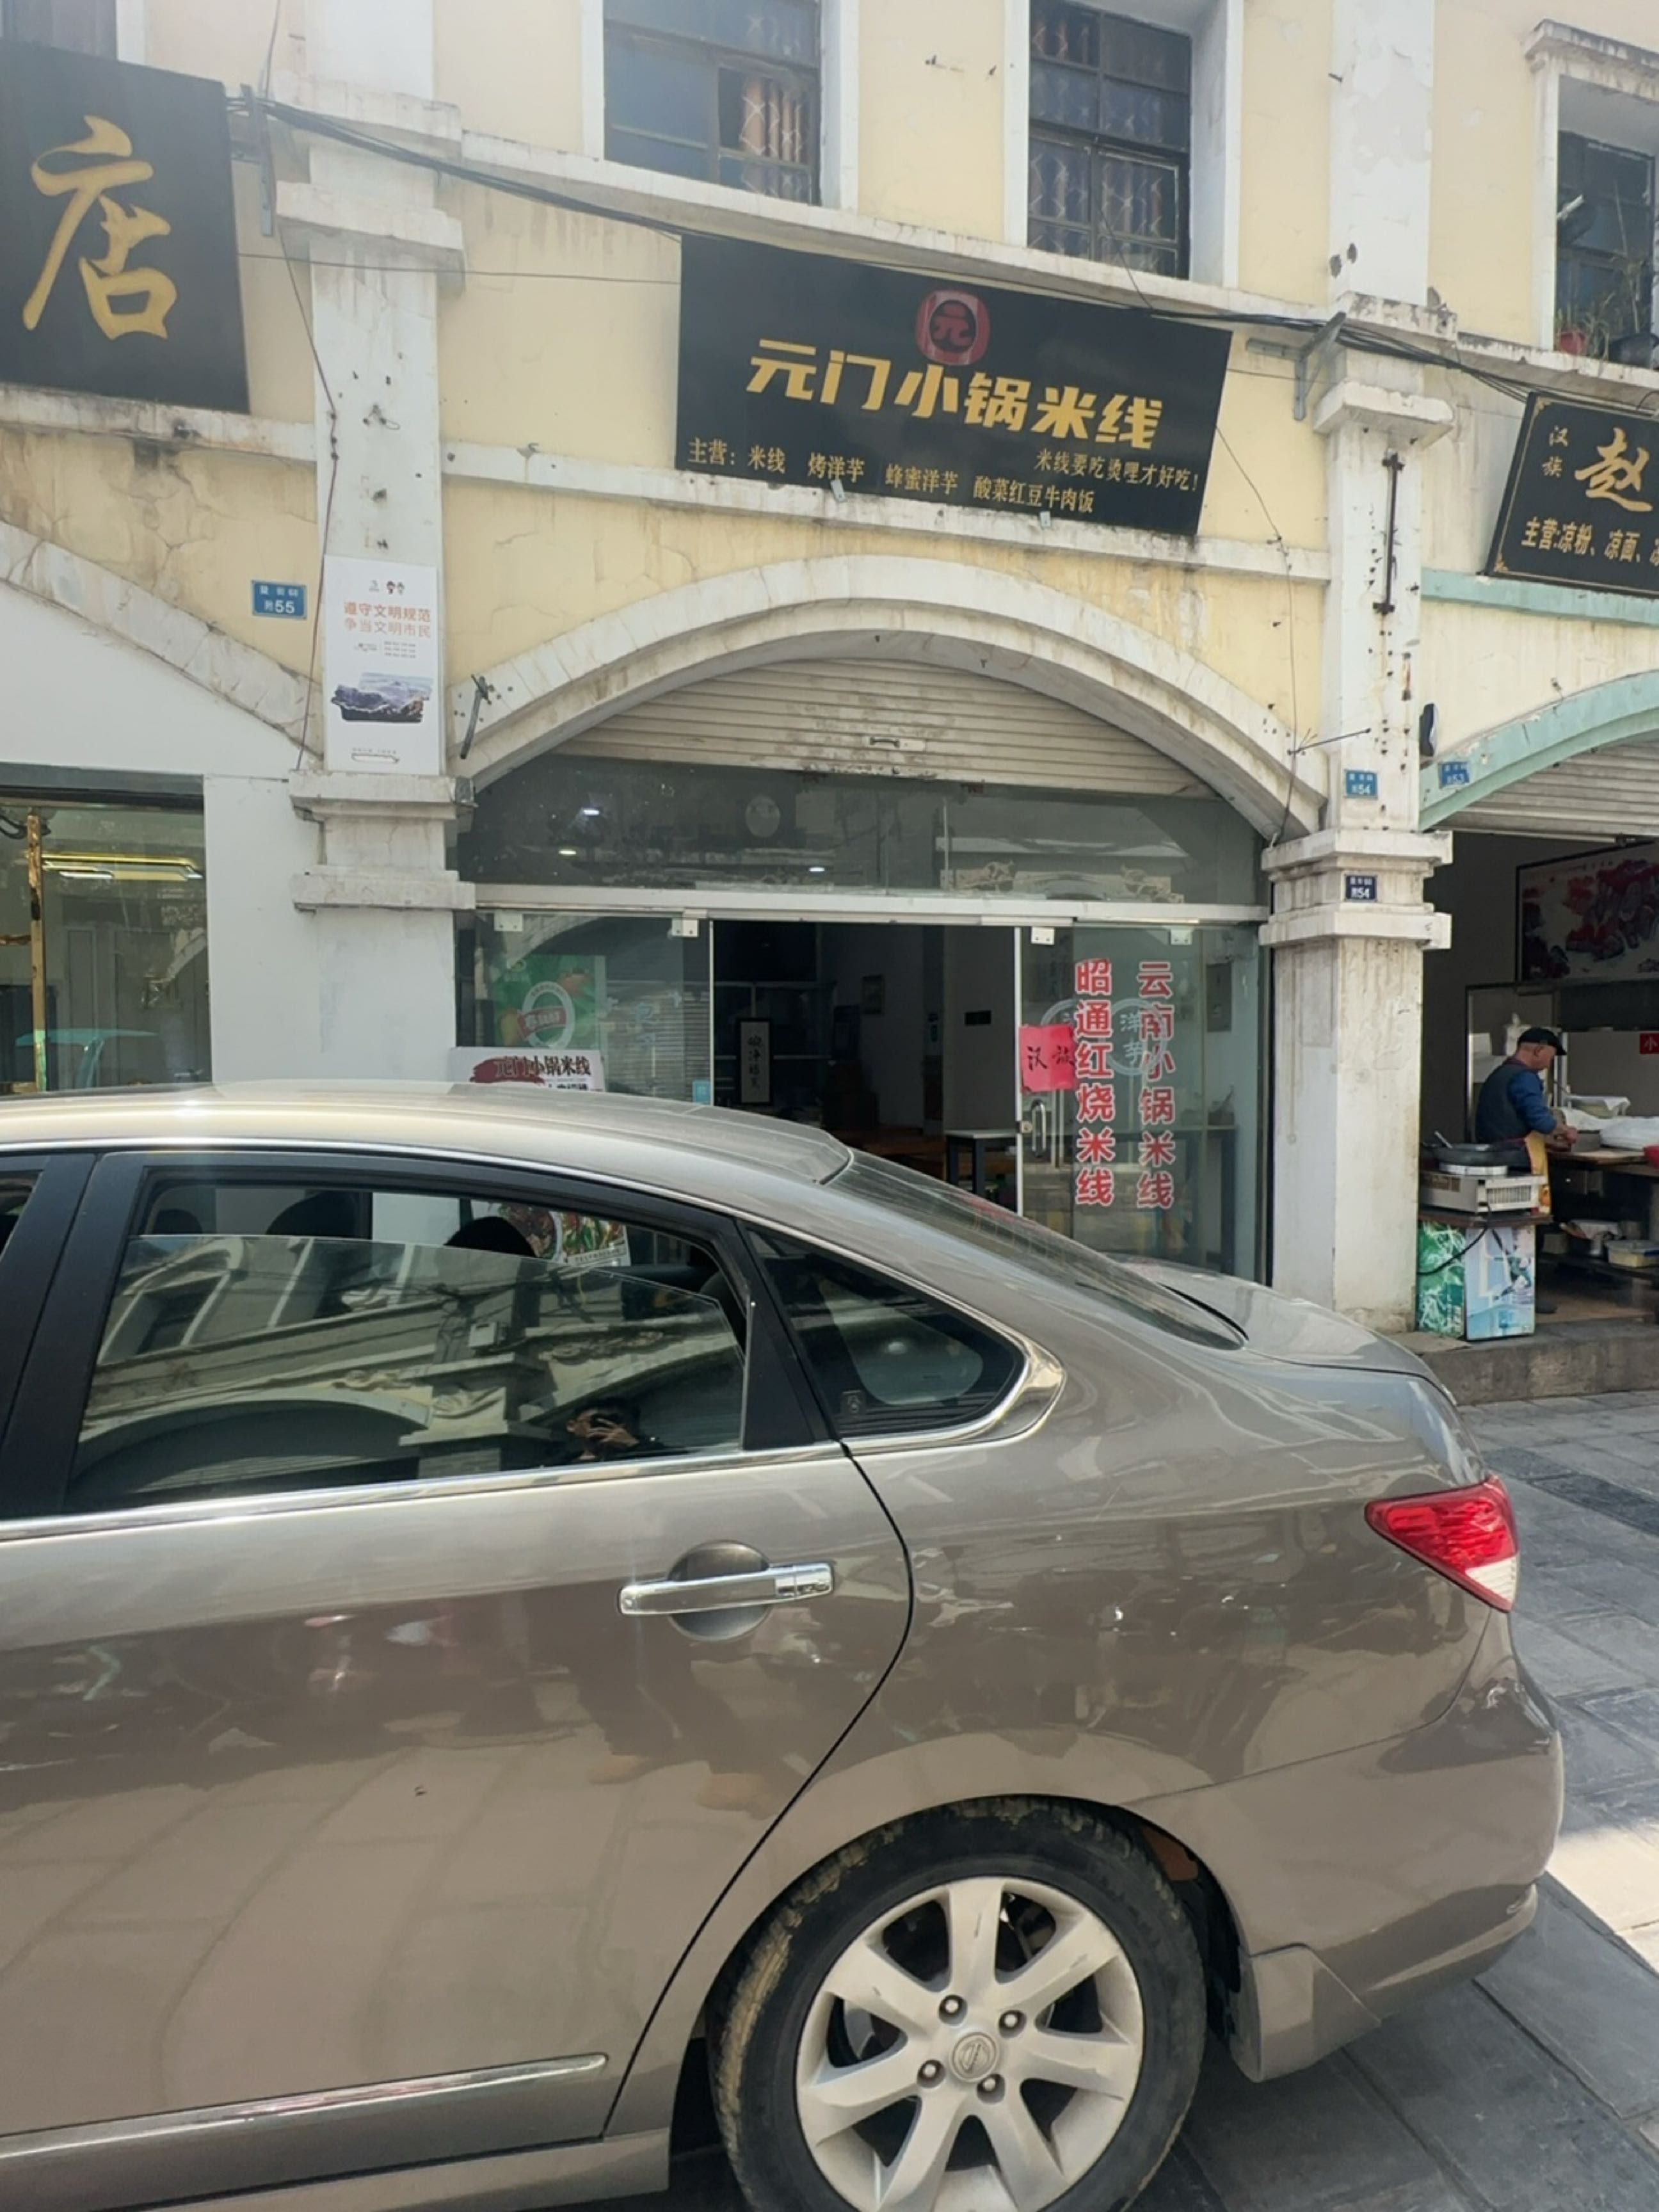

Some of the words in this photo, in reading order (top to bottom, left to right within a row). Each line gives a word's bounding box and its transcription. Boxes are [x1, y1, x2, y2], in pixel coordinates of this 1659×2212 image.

[22, 115, 178, 341] 店
[933, 303, 974, 346] 元
[746, 339, 1163, 449] 元门小锅米线
[807, 452, 865, 483] 烤洋芋
[885, 463, 958, 495] 蜂蜜洋芋
[973, 476, 1094, 513] 酸菜红豆牛肉饭
[1542, 425, 1569, 478] 汉族
[1575, 427, 1653, 512] 赵
[344, 602, 431, 623] 遵守文明规范
[344, 617, 431, 637] 争当文明市民
[1075, 959, 1115, 1205] 昭通红烧米线
[1137, 961, 1175, 1208] 云南小锅米线
